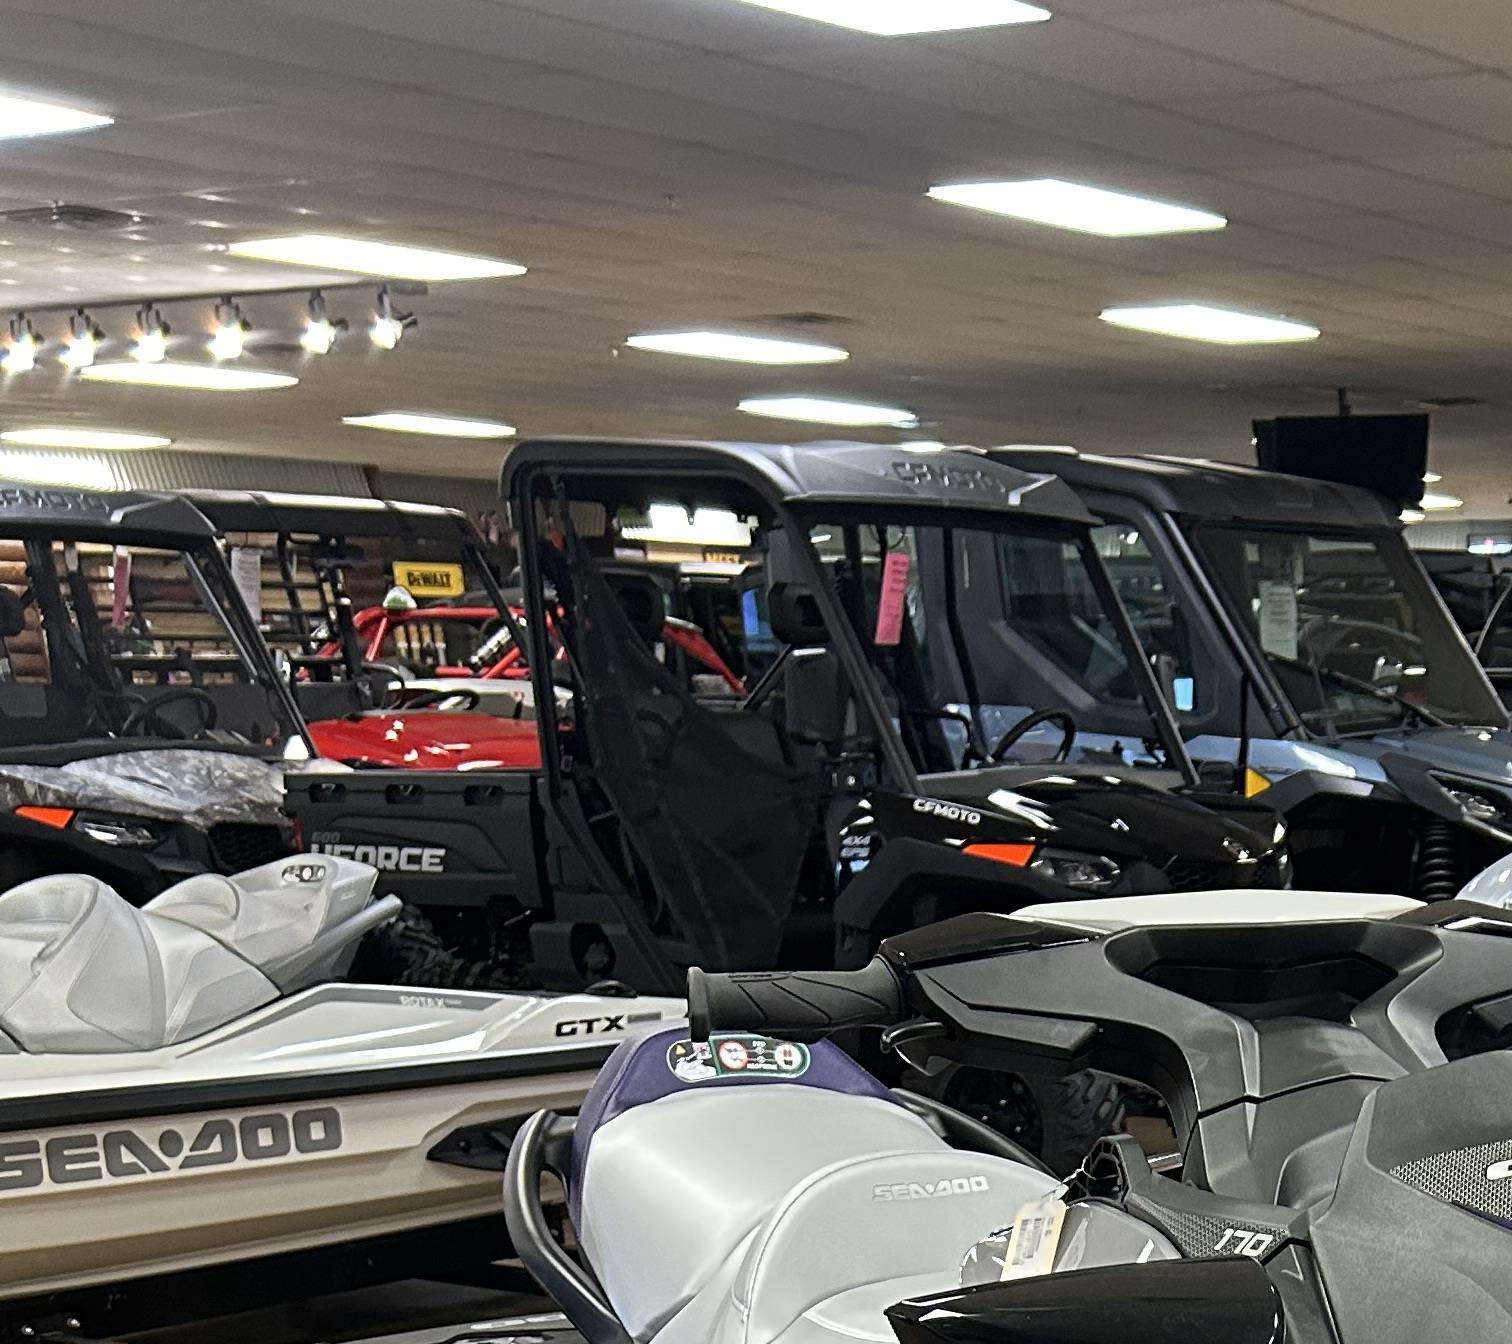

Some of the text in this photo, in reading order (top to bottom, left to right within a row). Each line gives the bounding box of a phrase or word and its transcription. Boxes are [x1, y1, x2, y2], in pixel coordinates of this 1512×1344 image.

[0, 488, 110, 514] FMOTO
[912, 798, 982, 826] CFMOTO
[555, 1015, 625, 1037] GTX
[1214, 1227, 1274, 1257] 170
